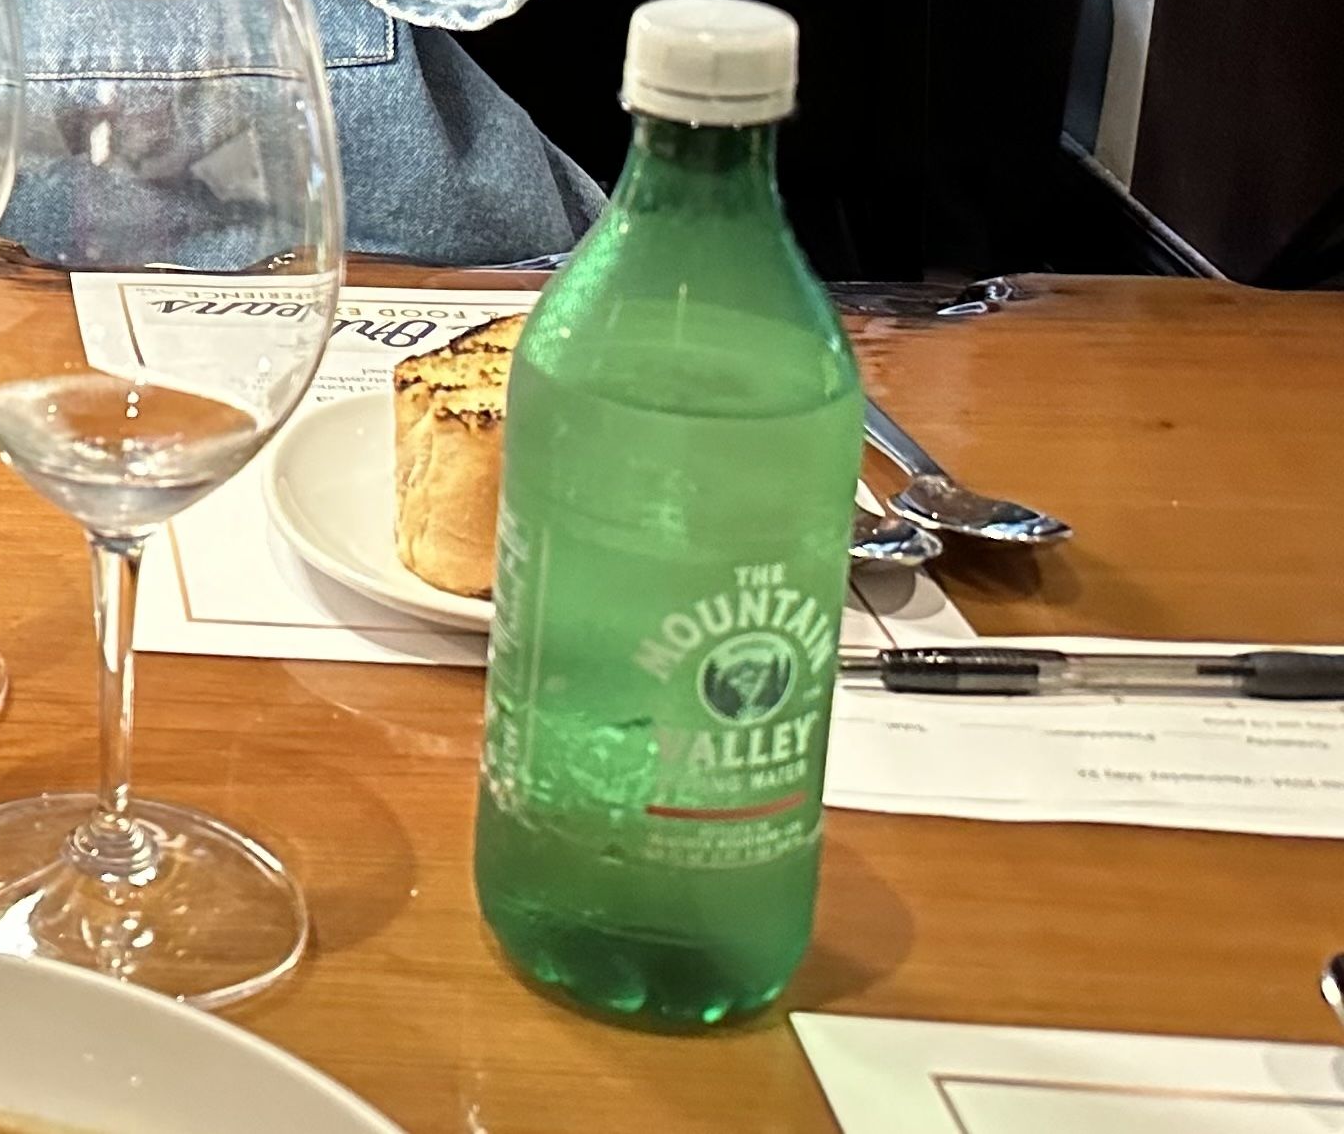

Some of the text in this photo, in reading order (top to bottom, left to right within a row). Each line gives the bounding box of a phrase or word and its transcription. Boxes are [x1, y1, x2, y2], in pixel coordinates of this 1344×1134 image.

[377, 306, 465, 320] FOOD
[734, 562, 786, 587] THE
[632, 587, 834, 684] MOUNTAIN
[657, 711, 819, 770] VALLEY
